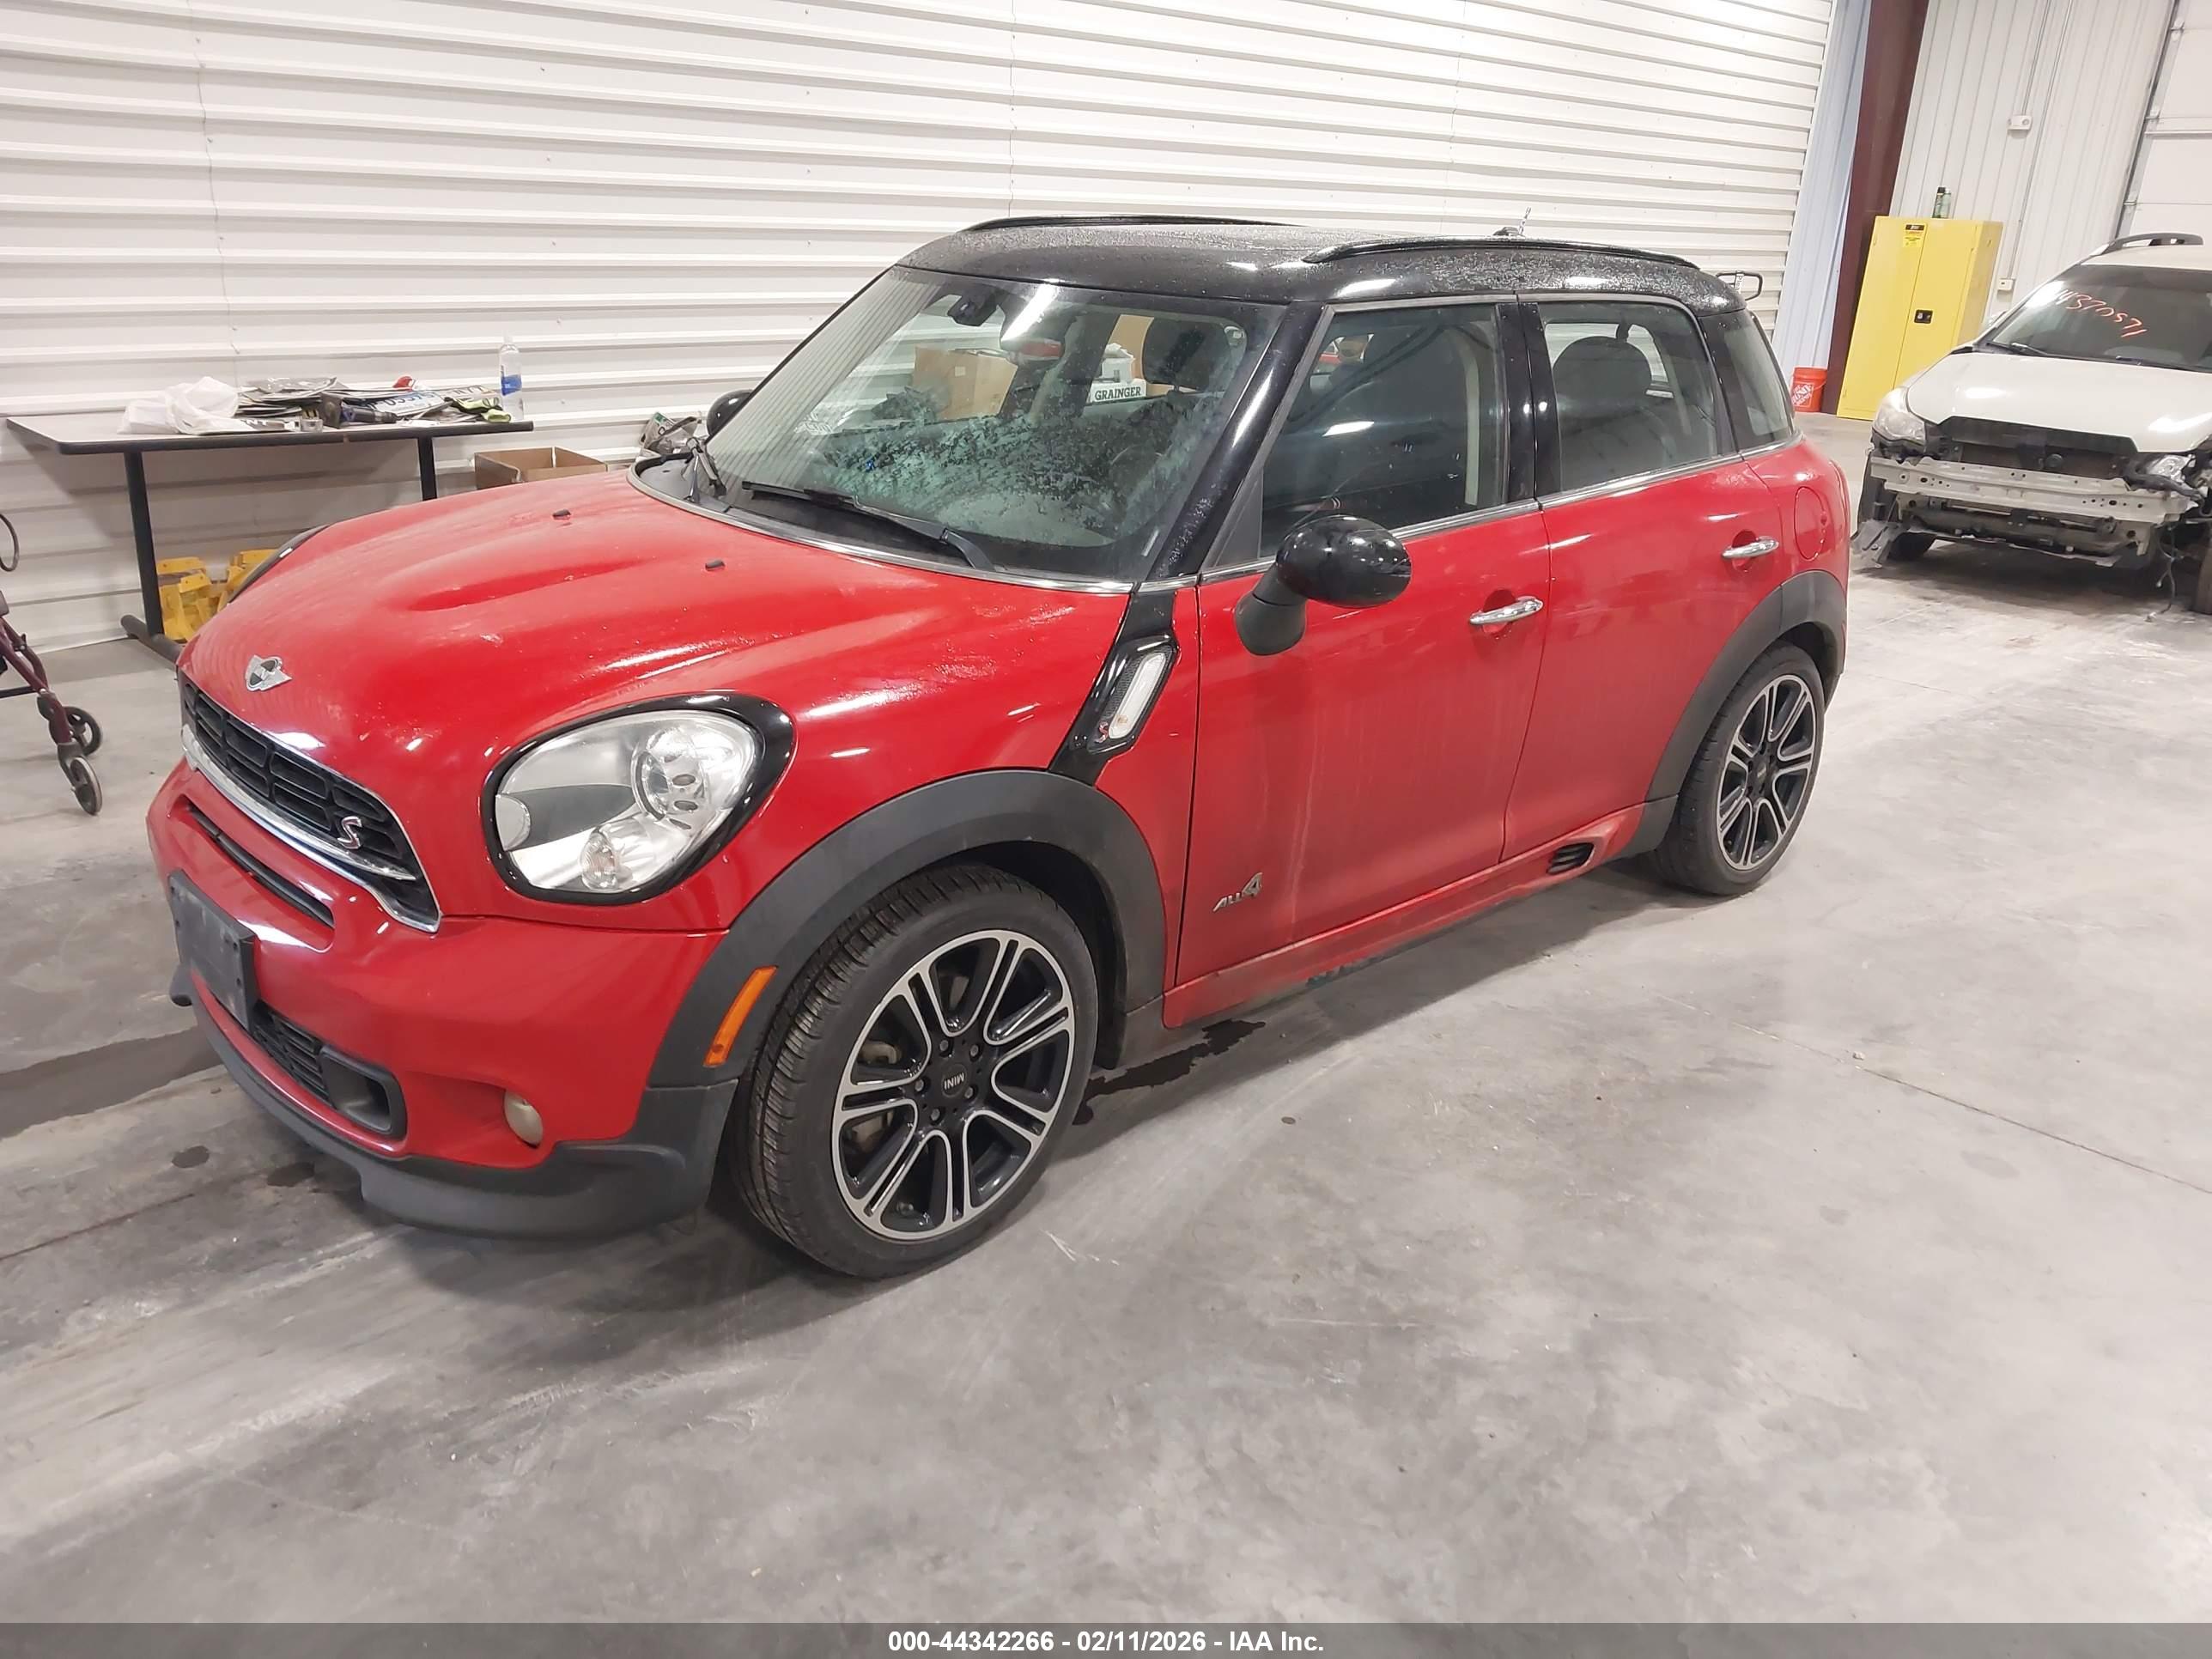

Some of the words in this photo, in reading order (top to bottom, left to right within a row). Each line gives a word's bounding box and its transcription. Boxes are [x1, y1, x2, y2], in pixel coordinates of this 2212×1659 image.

[1094, 386, 1141, 401] GRAINGER
[337, 816, 362, 849] S
[944, 1072, 965, 1091] MINI
